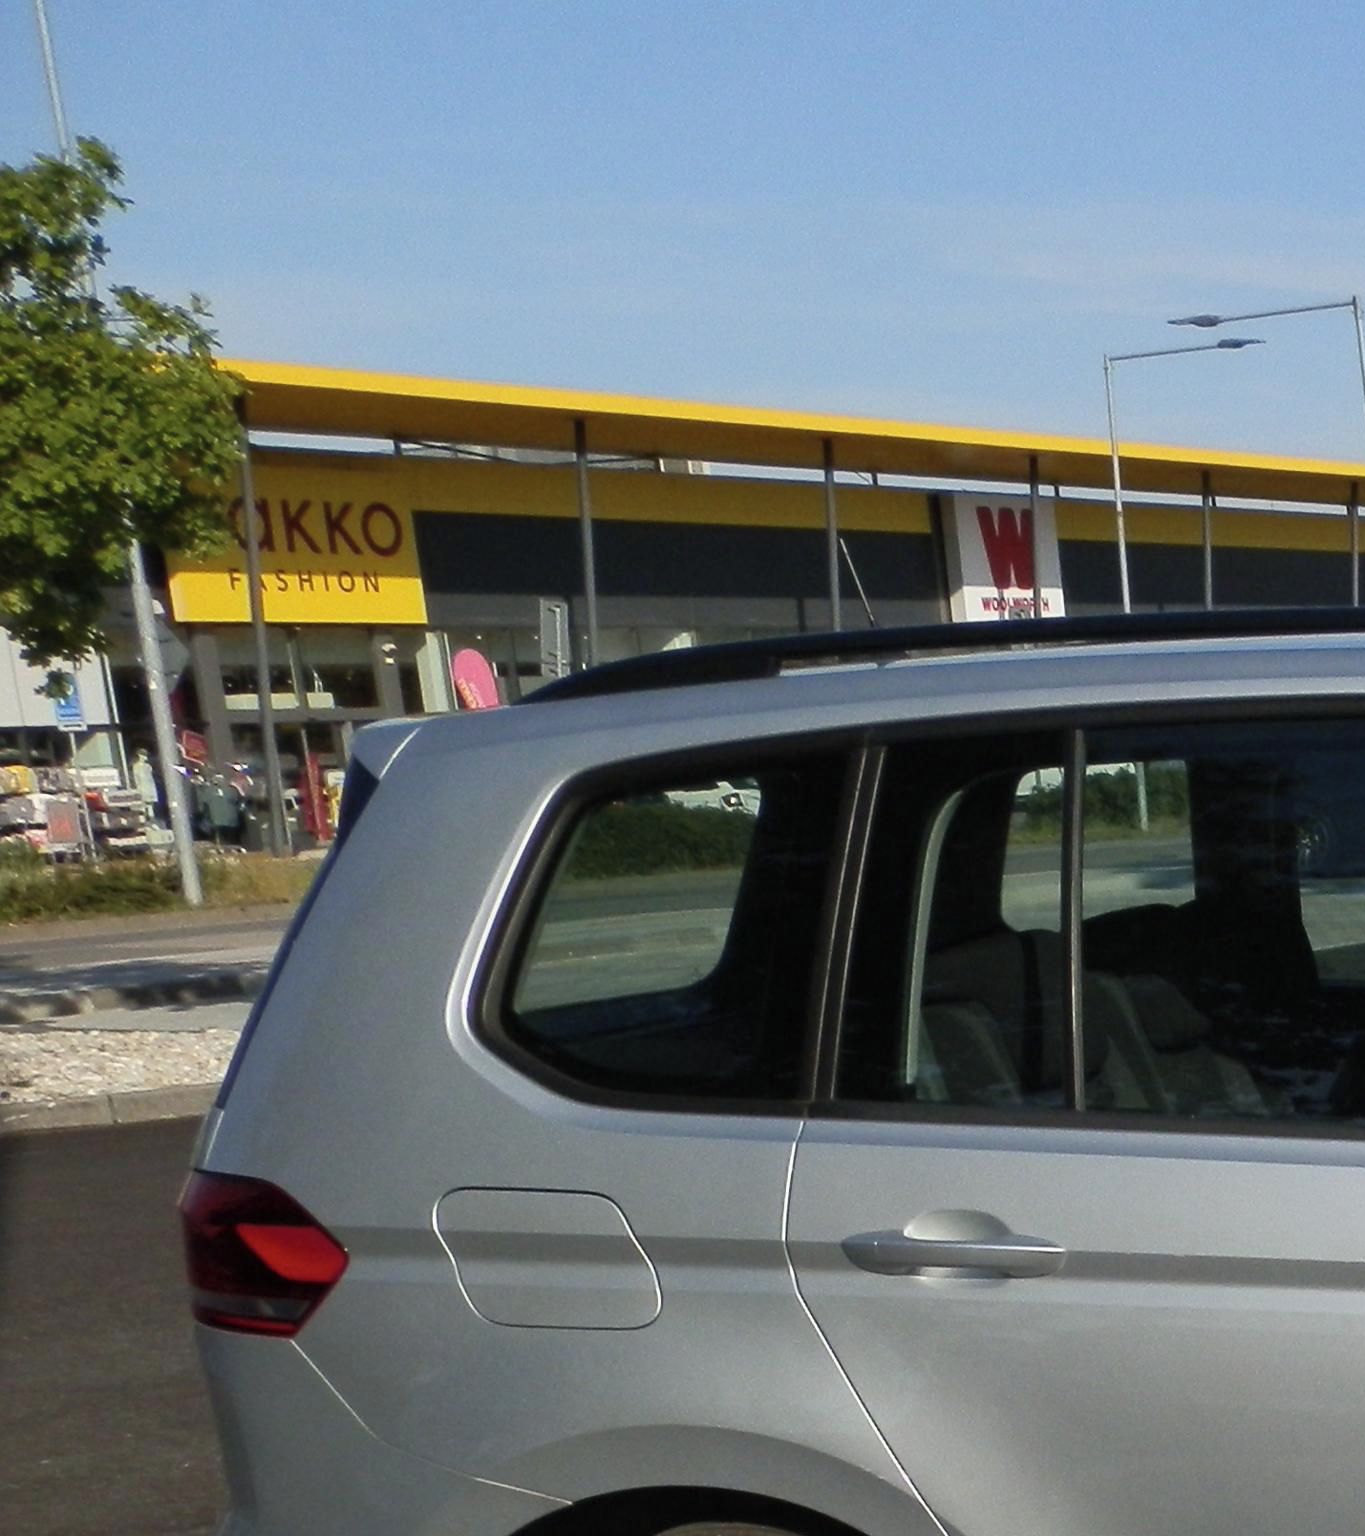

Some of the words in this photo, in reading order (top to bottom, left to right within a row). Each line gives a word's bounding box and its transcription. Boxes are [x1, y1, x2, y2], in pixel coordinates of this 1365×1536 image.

[976, 506, 1035, 590] W
[228, 568, 380, 593] FSHION
[981, 596, 1050, 612] WOOLWORH
